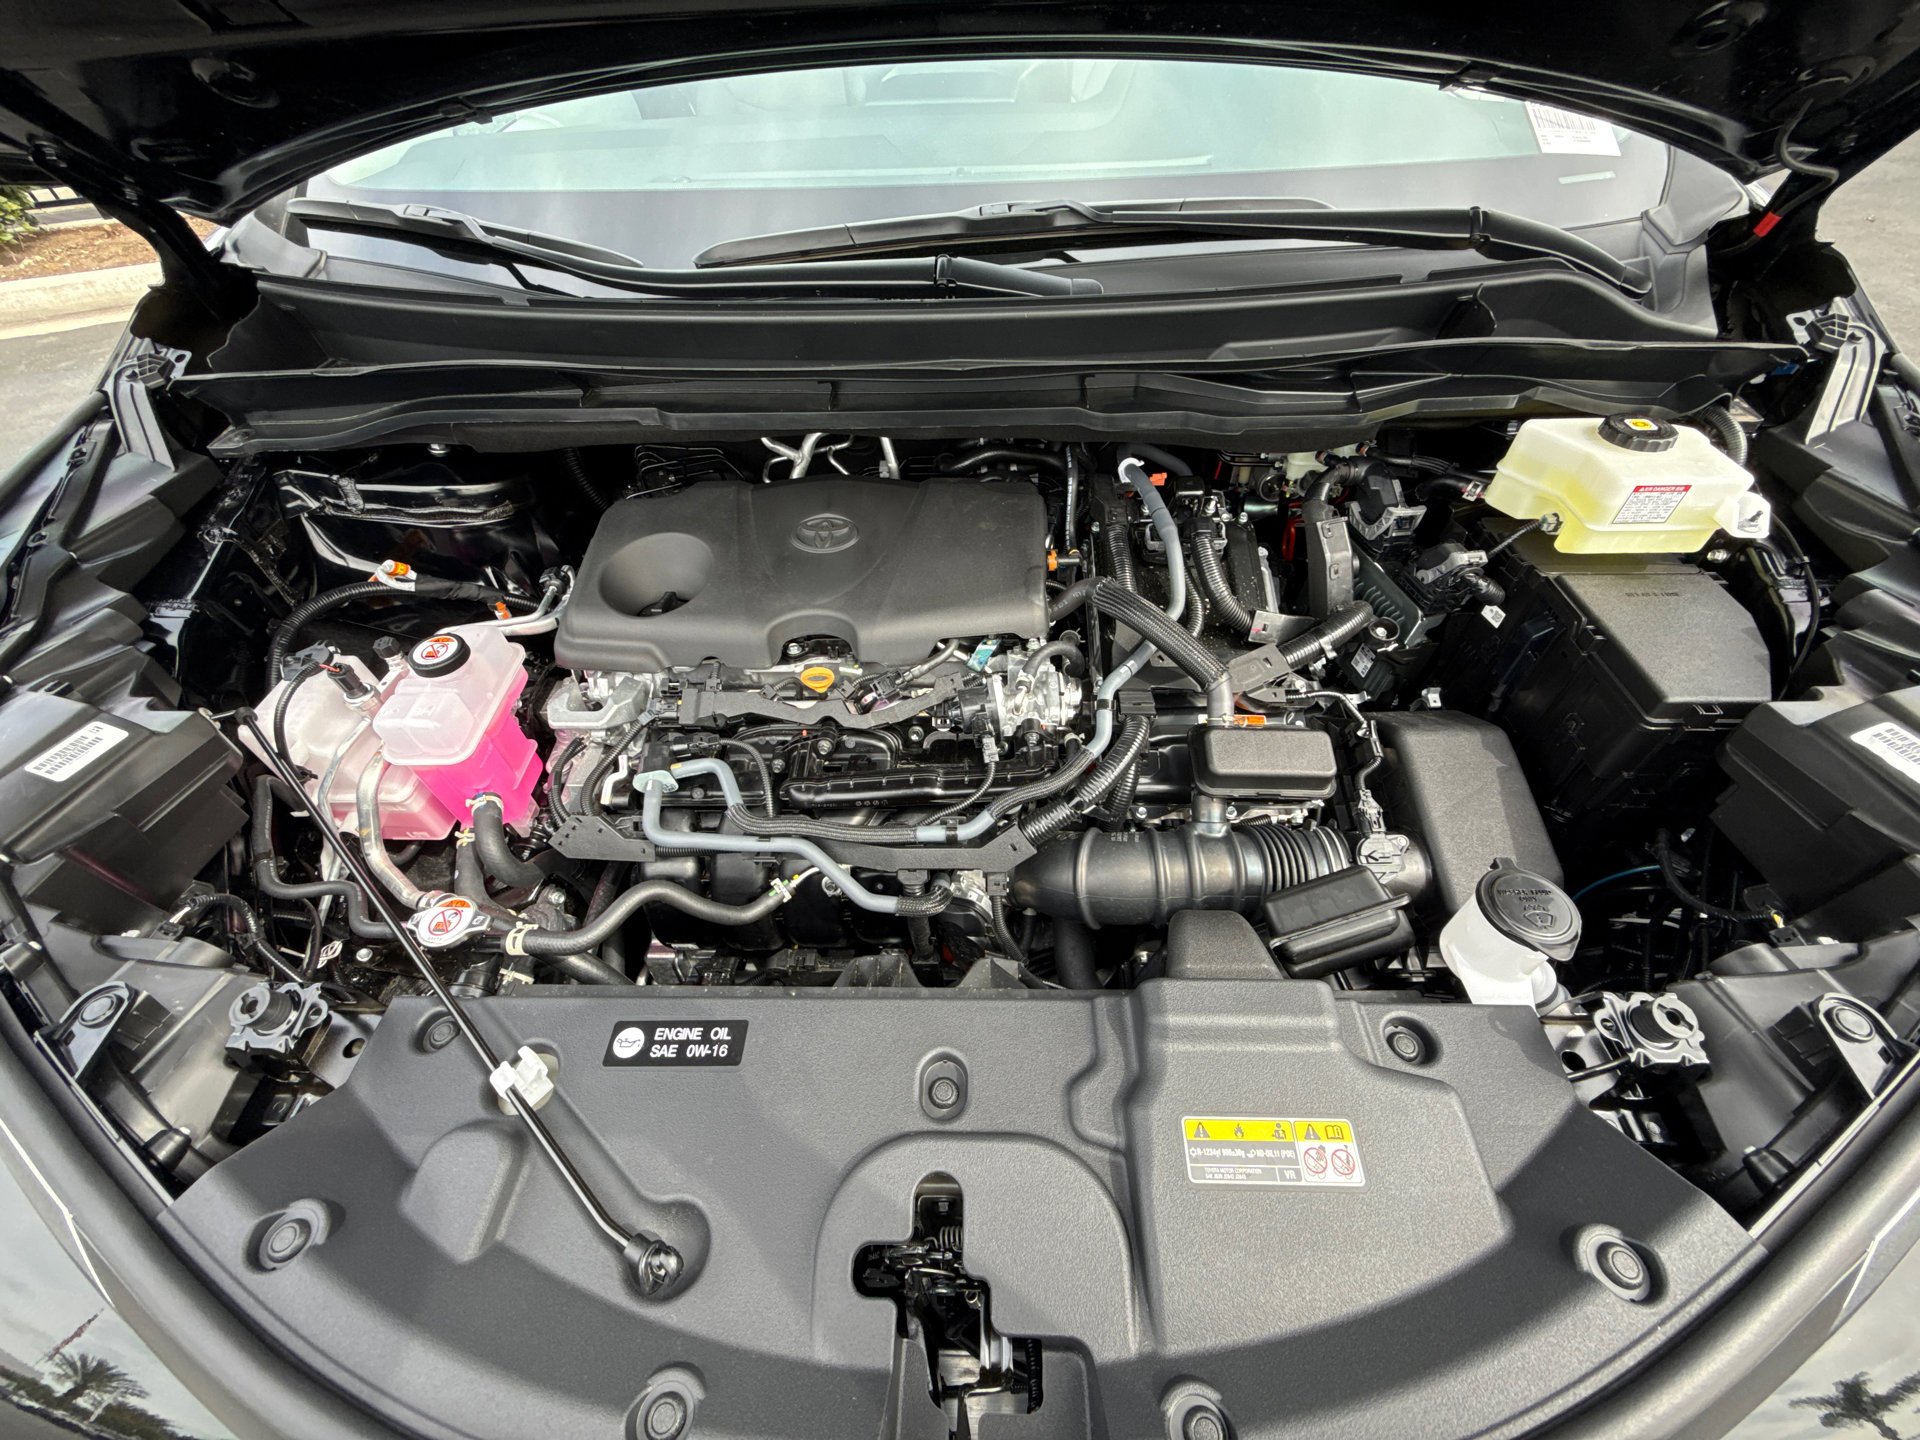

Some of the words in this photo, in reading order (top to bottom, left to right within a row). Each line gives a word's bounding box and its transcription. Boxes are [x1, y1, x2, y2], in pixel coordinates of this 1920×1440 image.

[654, 1027, 704, 1040] ENGINE
[710, 1027, 731, 1040] OIL
[649, 1044, 679, 1058] SAE
[686, 1044, 729, 1057] 0W-16
[1283, 1170, 1297, 1180] VR
